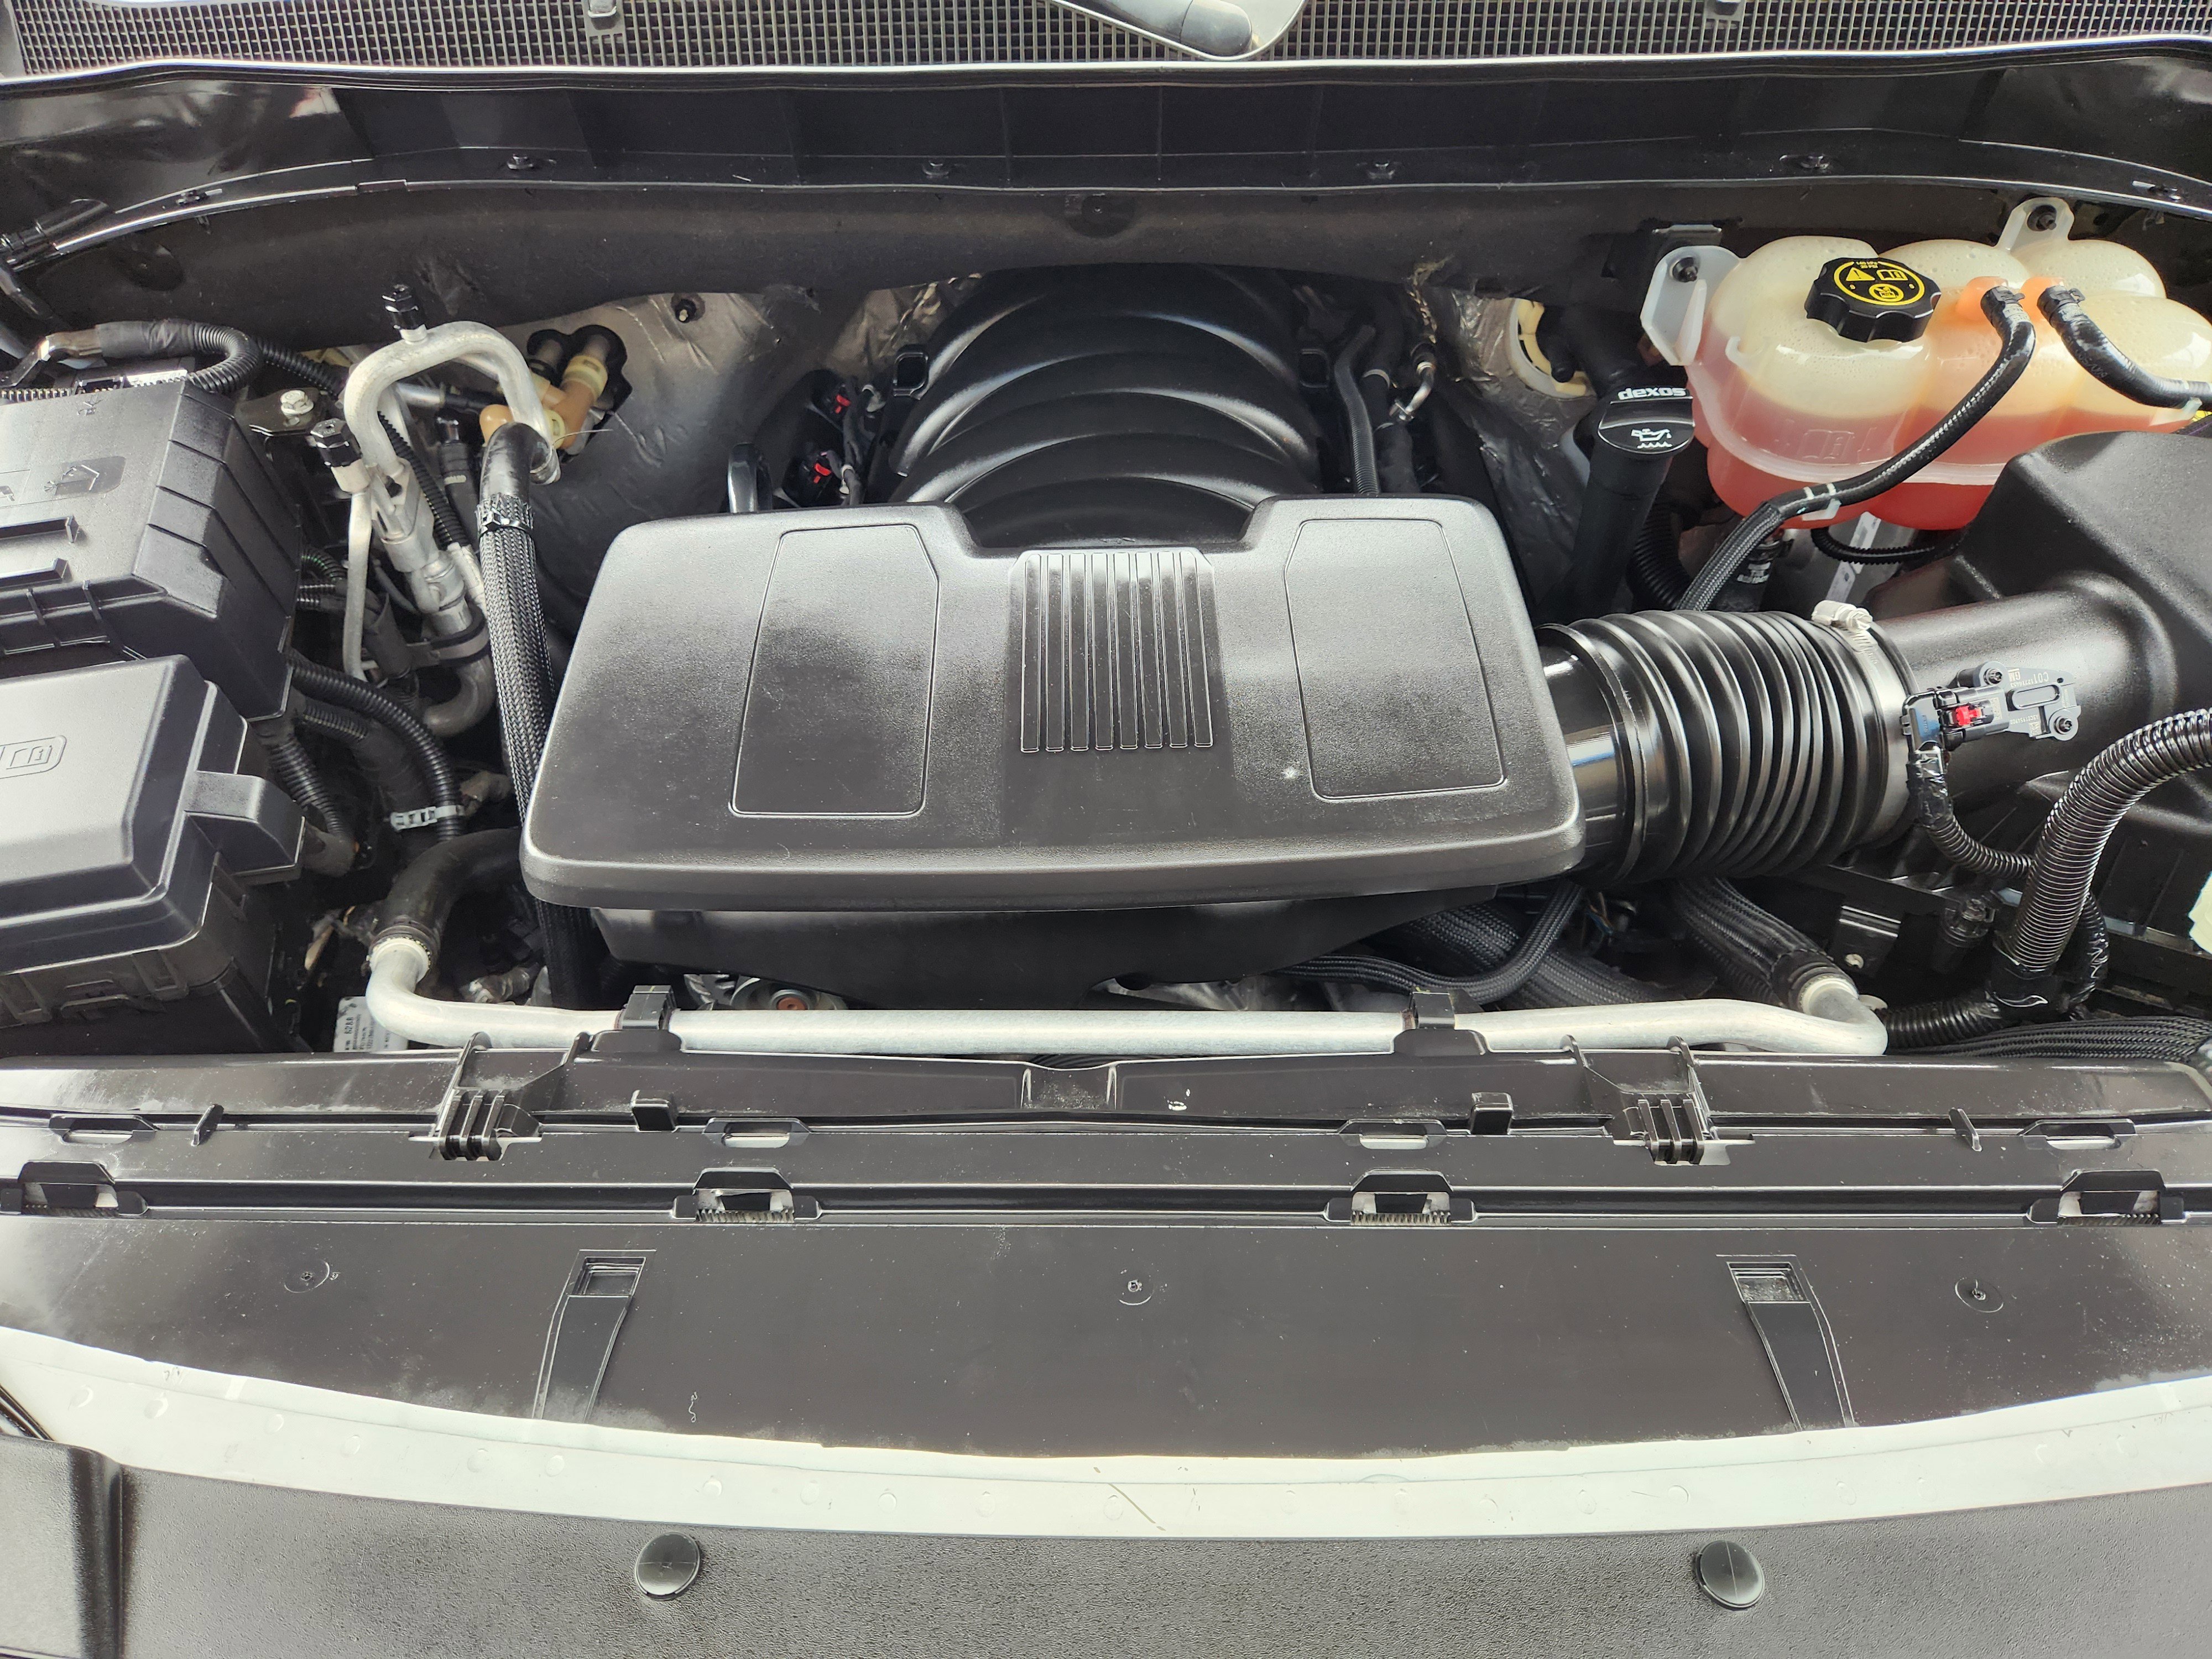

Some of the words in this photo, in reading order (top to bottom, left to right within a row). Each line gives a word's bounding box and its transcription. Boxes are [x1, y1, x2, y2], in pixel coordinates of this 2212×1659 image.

[1618, 387, 1686, 399] dexos
[2008, 671, 2021, 682] GM
[2033, 671, 2049, 684] C01
